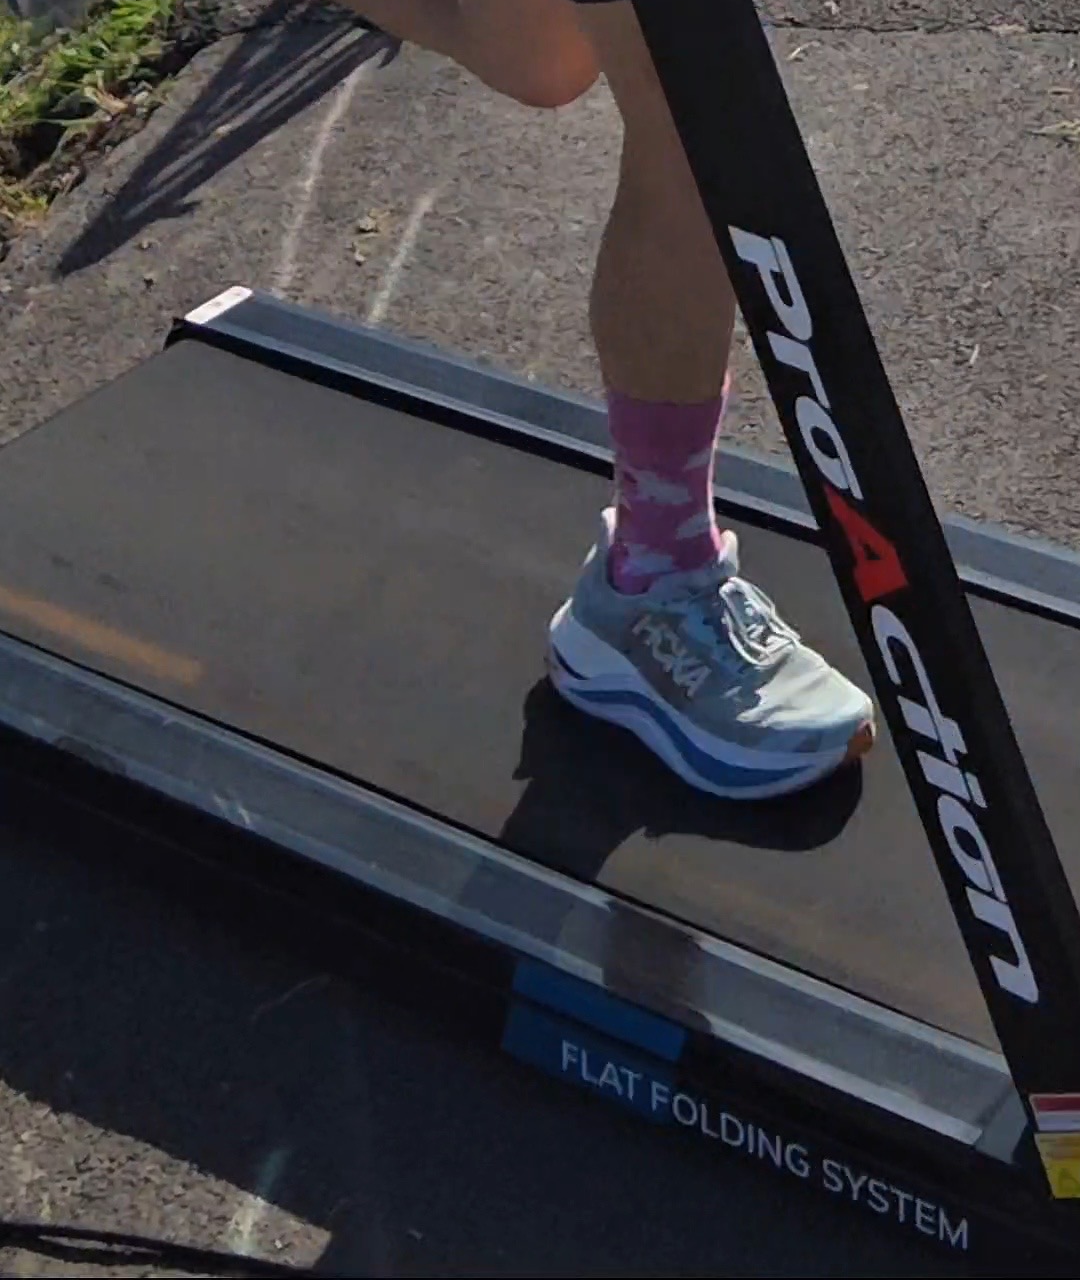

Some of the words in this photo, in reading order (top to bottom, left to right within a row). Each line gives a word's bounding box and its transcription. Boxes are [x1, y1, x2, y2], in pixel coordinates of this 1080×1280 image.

[561, 1040, 645, 1102] FLAT
[651, 1079, 810, 1178] FOLDING
[823, 1158, 969, 1250] SYSTEM
